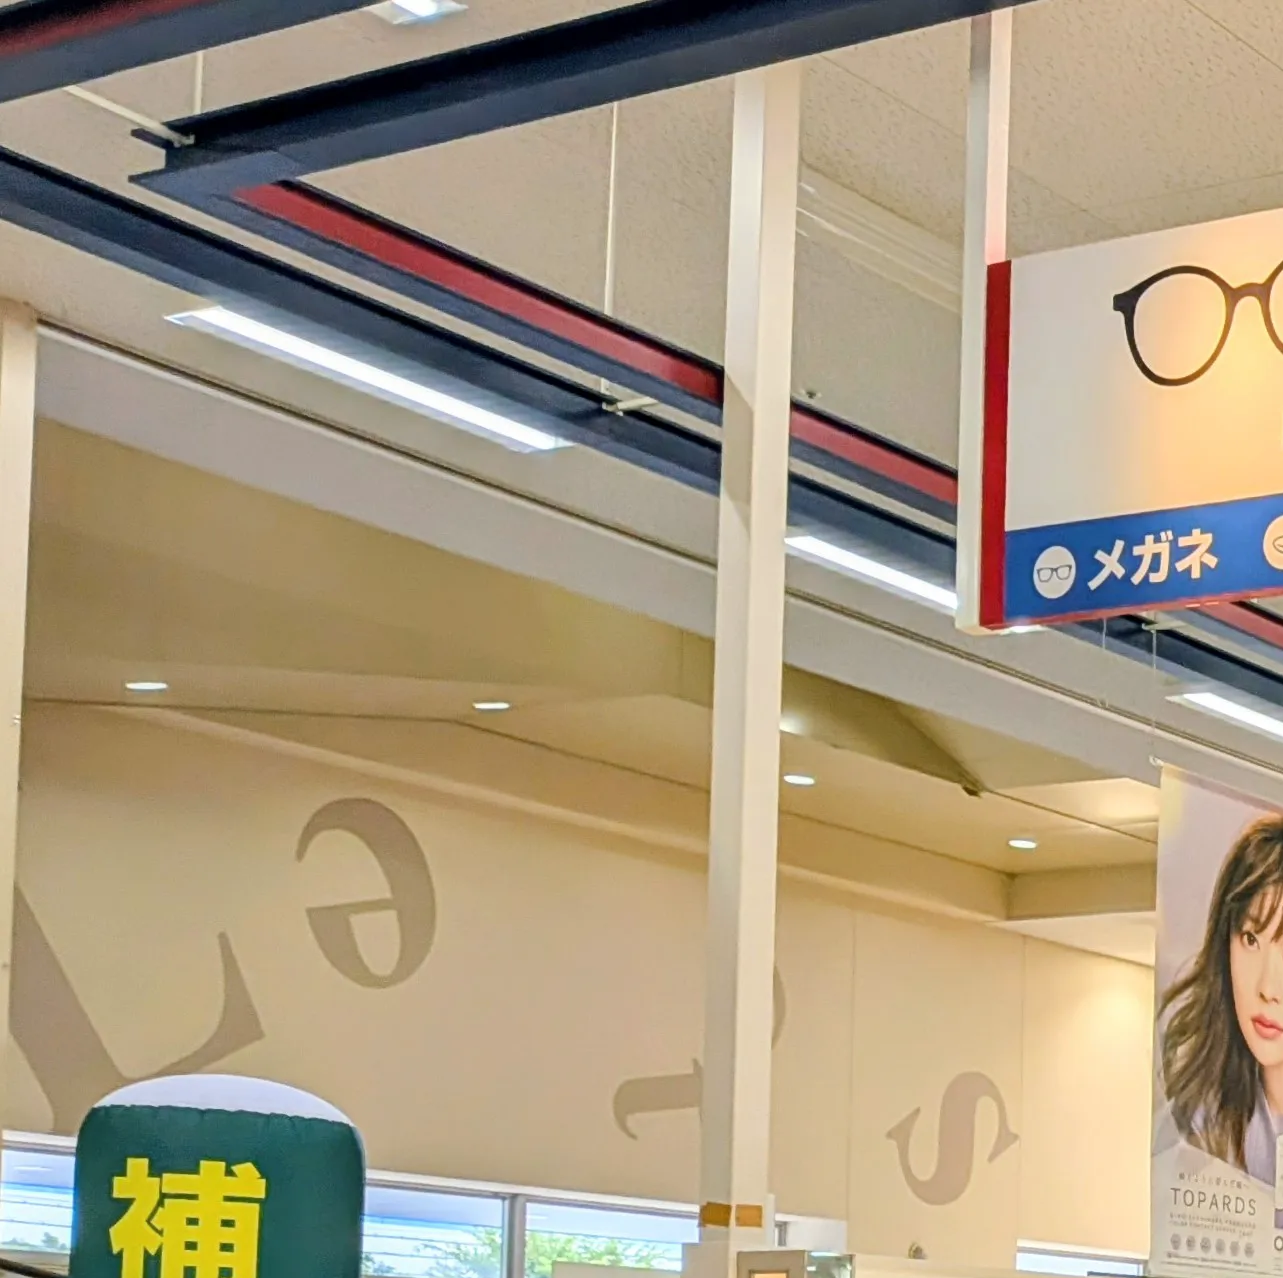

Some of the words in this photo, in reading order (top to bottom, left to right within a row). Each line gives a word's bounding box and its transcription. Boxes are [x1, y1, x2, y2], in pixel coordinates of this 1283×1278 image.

[1086, 529, 1220, 590] メガネ
[1170, 1187, 1257, 1216] TOPARDS
